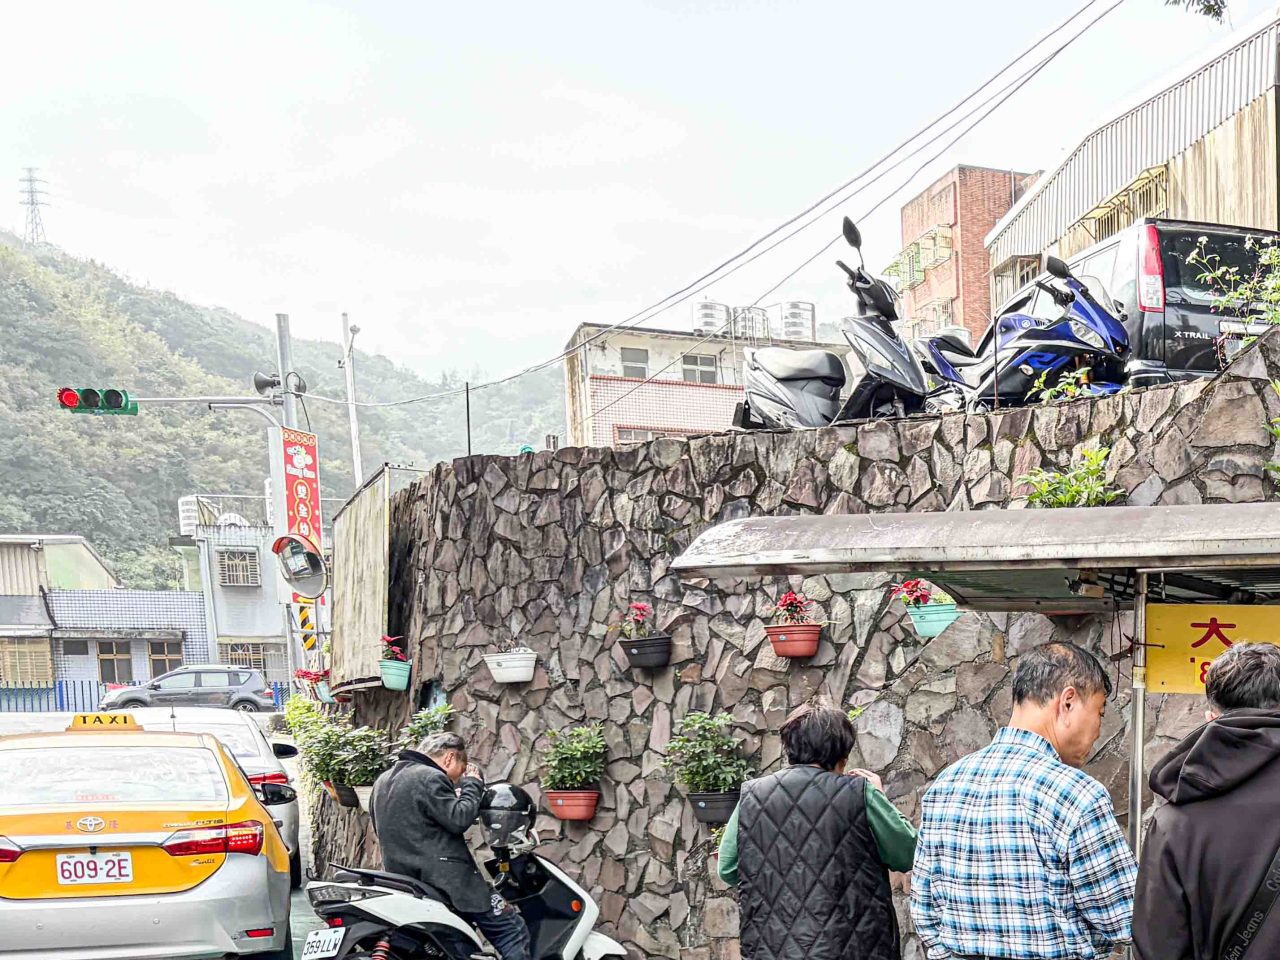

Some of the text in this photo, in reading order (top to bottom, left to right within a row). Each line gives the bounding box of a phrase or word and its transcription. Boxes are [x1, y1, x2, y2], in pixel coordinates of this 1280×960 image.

[1174, 330, 1211, 340] X TRAIL
[1190, 617, 1237, 649] 大
[80, 715, 128, 725] TAXI
[60, 858, 130, 880] 609-2E
